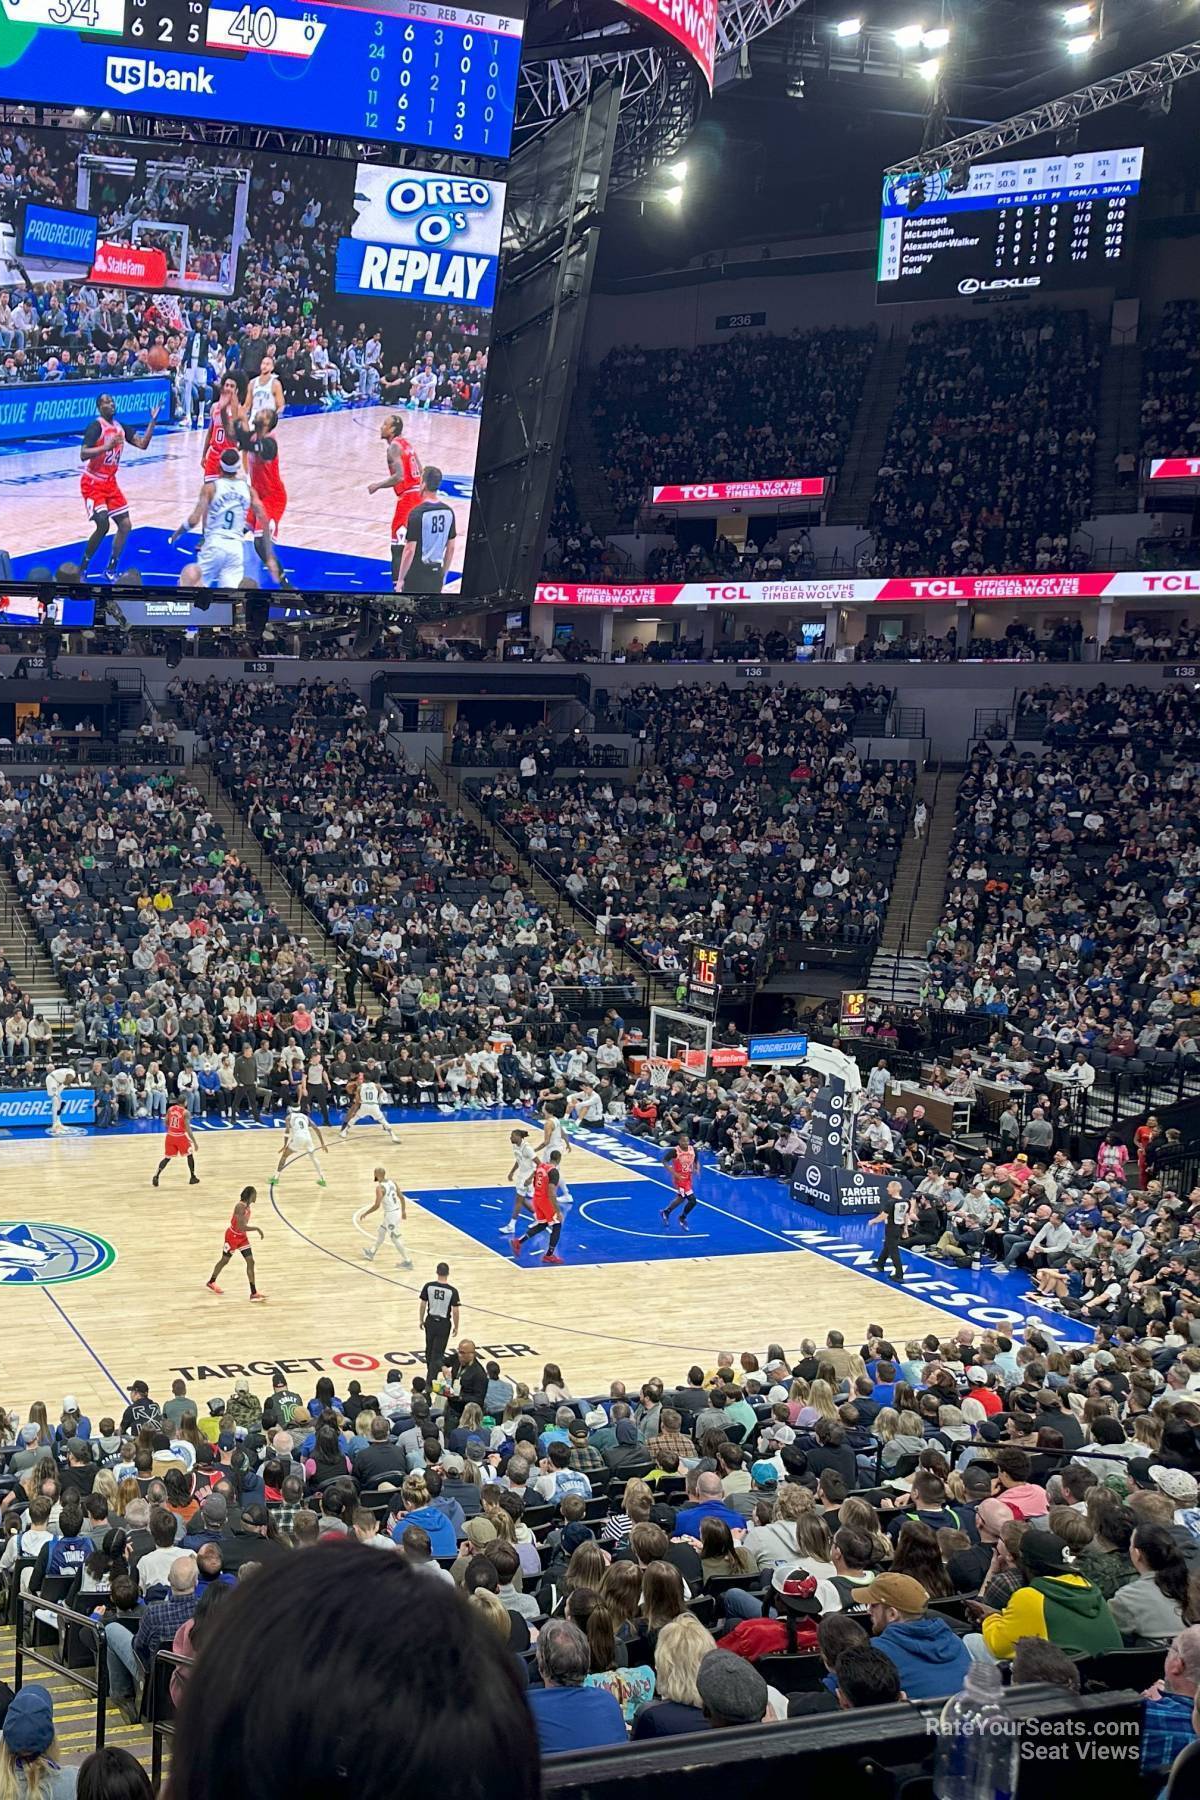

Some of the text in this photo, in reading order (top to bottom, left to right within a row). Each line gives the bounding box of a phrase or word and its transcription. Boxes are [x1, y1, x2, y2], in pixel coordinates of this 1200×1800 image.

[188, 2, 203, 14] TO
[408, 3, 511, 30] PTS REB AST PF
[131, 17, 199, 43] 6 2 5
[228, 5, 277, 47] 40
[304, 26, 315, 41] 0
[374, 21, 498, 55] 3 6 3 0 1
[369, 44, 498, 78] 24 0 1 0 0
[370, 67, 496, 100] 0 0 2 1 0
[368, 90, 494, 122] 11 6 1 3 0
[365, 112, 489, 144] 12 5 1 3 1
[389, 180, 490, 213] OREO
[904, 216, 947, 227] Anderson
[25, 219, 93, 250] PROGRESSIVE
[904, 227, 955, 240] McLaughlin
[903, 237, 980, 252] Alexander-Walker
[902, 253, 933, 265] Conley
[358, 245, 490, 300] REPLAY
[901, 265, 922, 276] Reid
[980, 276, 1041, 291] LEXUS
[728, 315, 752, 327] 236
[103, 447, 120, 466] 24
[680, 486, 719, 499] TCL
[224, 510, 235, 530] 9
[431, 514, 445, 534] 83
[762, 585, 805, 593] OFFICIAL
[911, 581, 963, 596] TCL
[974, 578, 1079, 588] OFFICIAL TV OF THE
[1143, 575, 1199, 591] TCL
[706, 586, 751, 601] TCL
[762, 591, 855, 600] TIMBERWOLVES
[974, 586, 1079, 596] TIMBERWOLVES
[27, 658, 45, 668] 132
[250, 663, 268, 672] 133
[745, 667, 762, 676] 136
[1174, 667, 1196, 677] 138
[699, 961, 715, 984] 16
[752, 1041, 804, 1055] PROGRESSIVE
[365, 1091, 374, 1101] 10
[793, 1181, 830, 1202] CFMOTO
[841, 1186, 879, 1196] TARGET
[842, 1195, 881, 1206] CENTER
[434, 1289, 445, 1300] 83
[170, 1357, 325, 1382] TARGET
